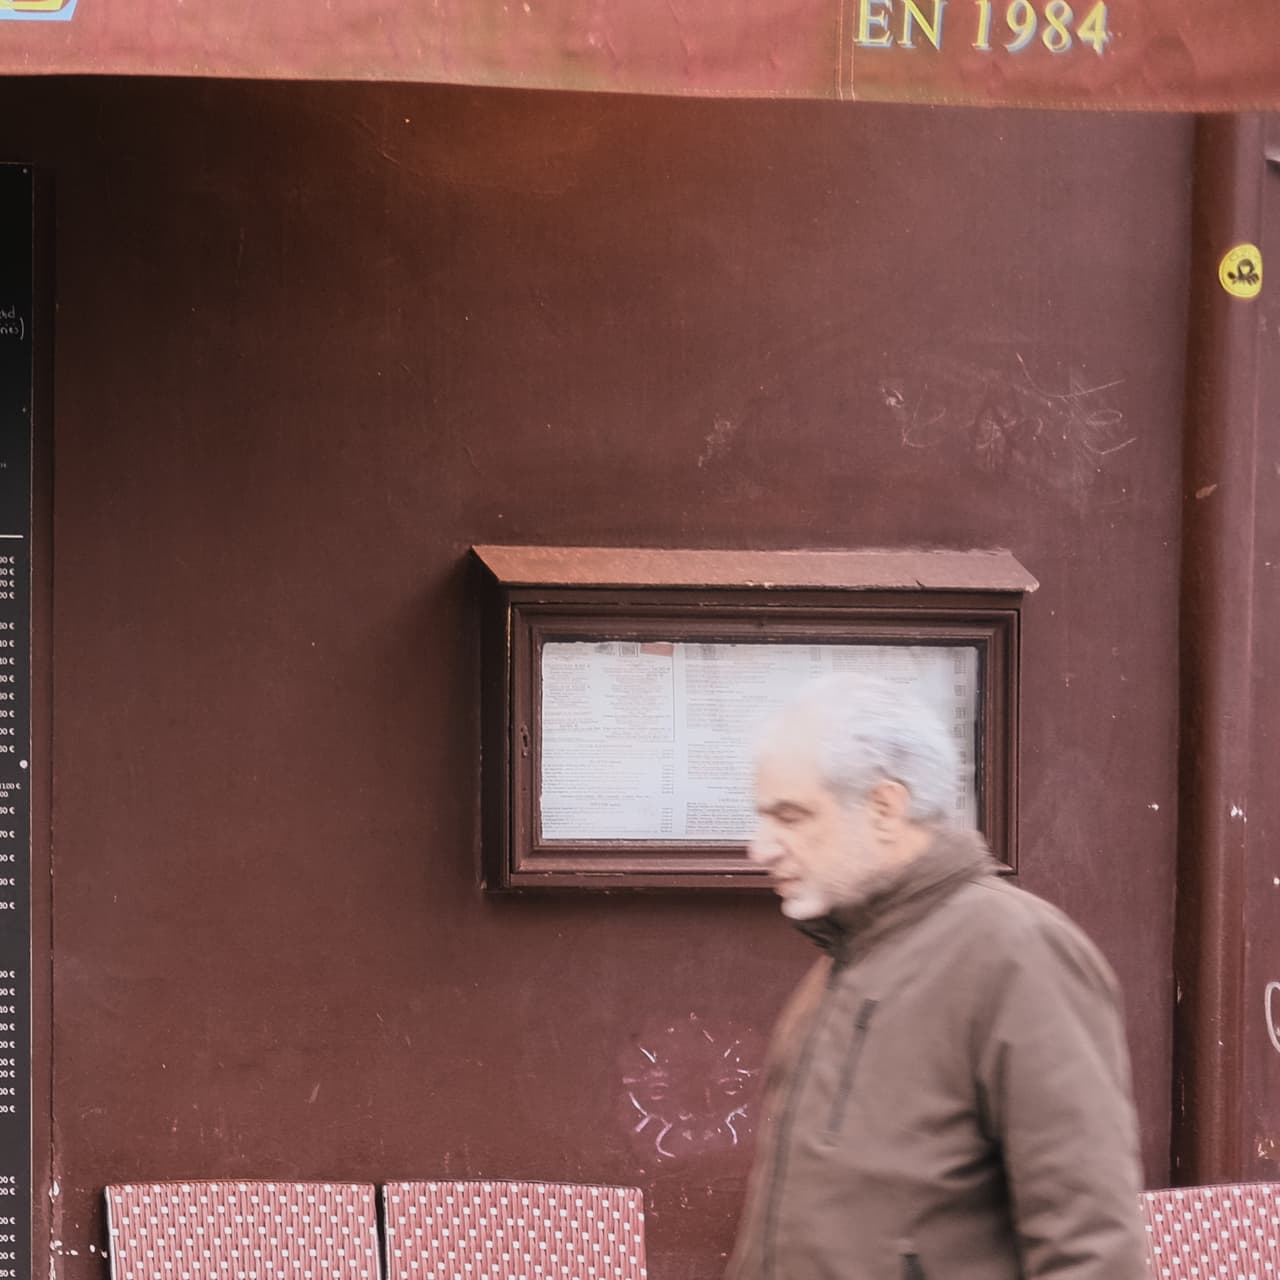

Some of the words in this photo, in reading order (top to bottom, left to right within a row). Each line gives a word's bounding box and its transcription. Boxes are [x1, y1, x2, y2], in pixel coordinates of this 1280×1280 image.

[853, 0, 946, 49] EN
[971, 0, 1113, 54] 1984
[10, 1176, 15, 1184] €
